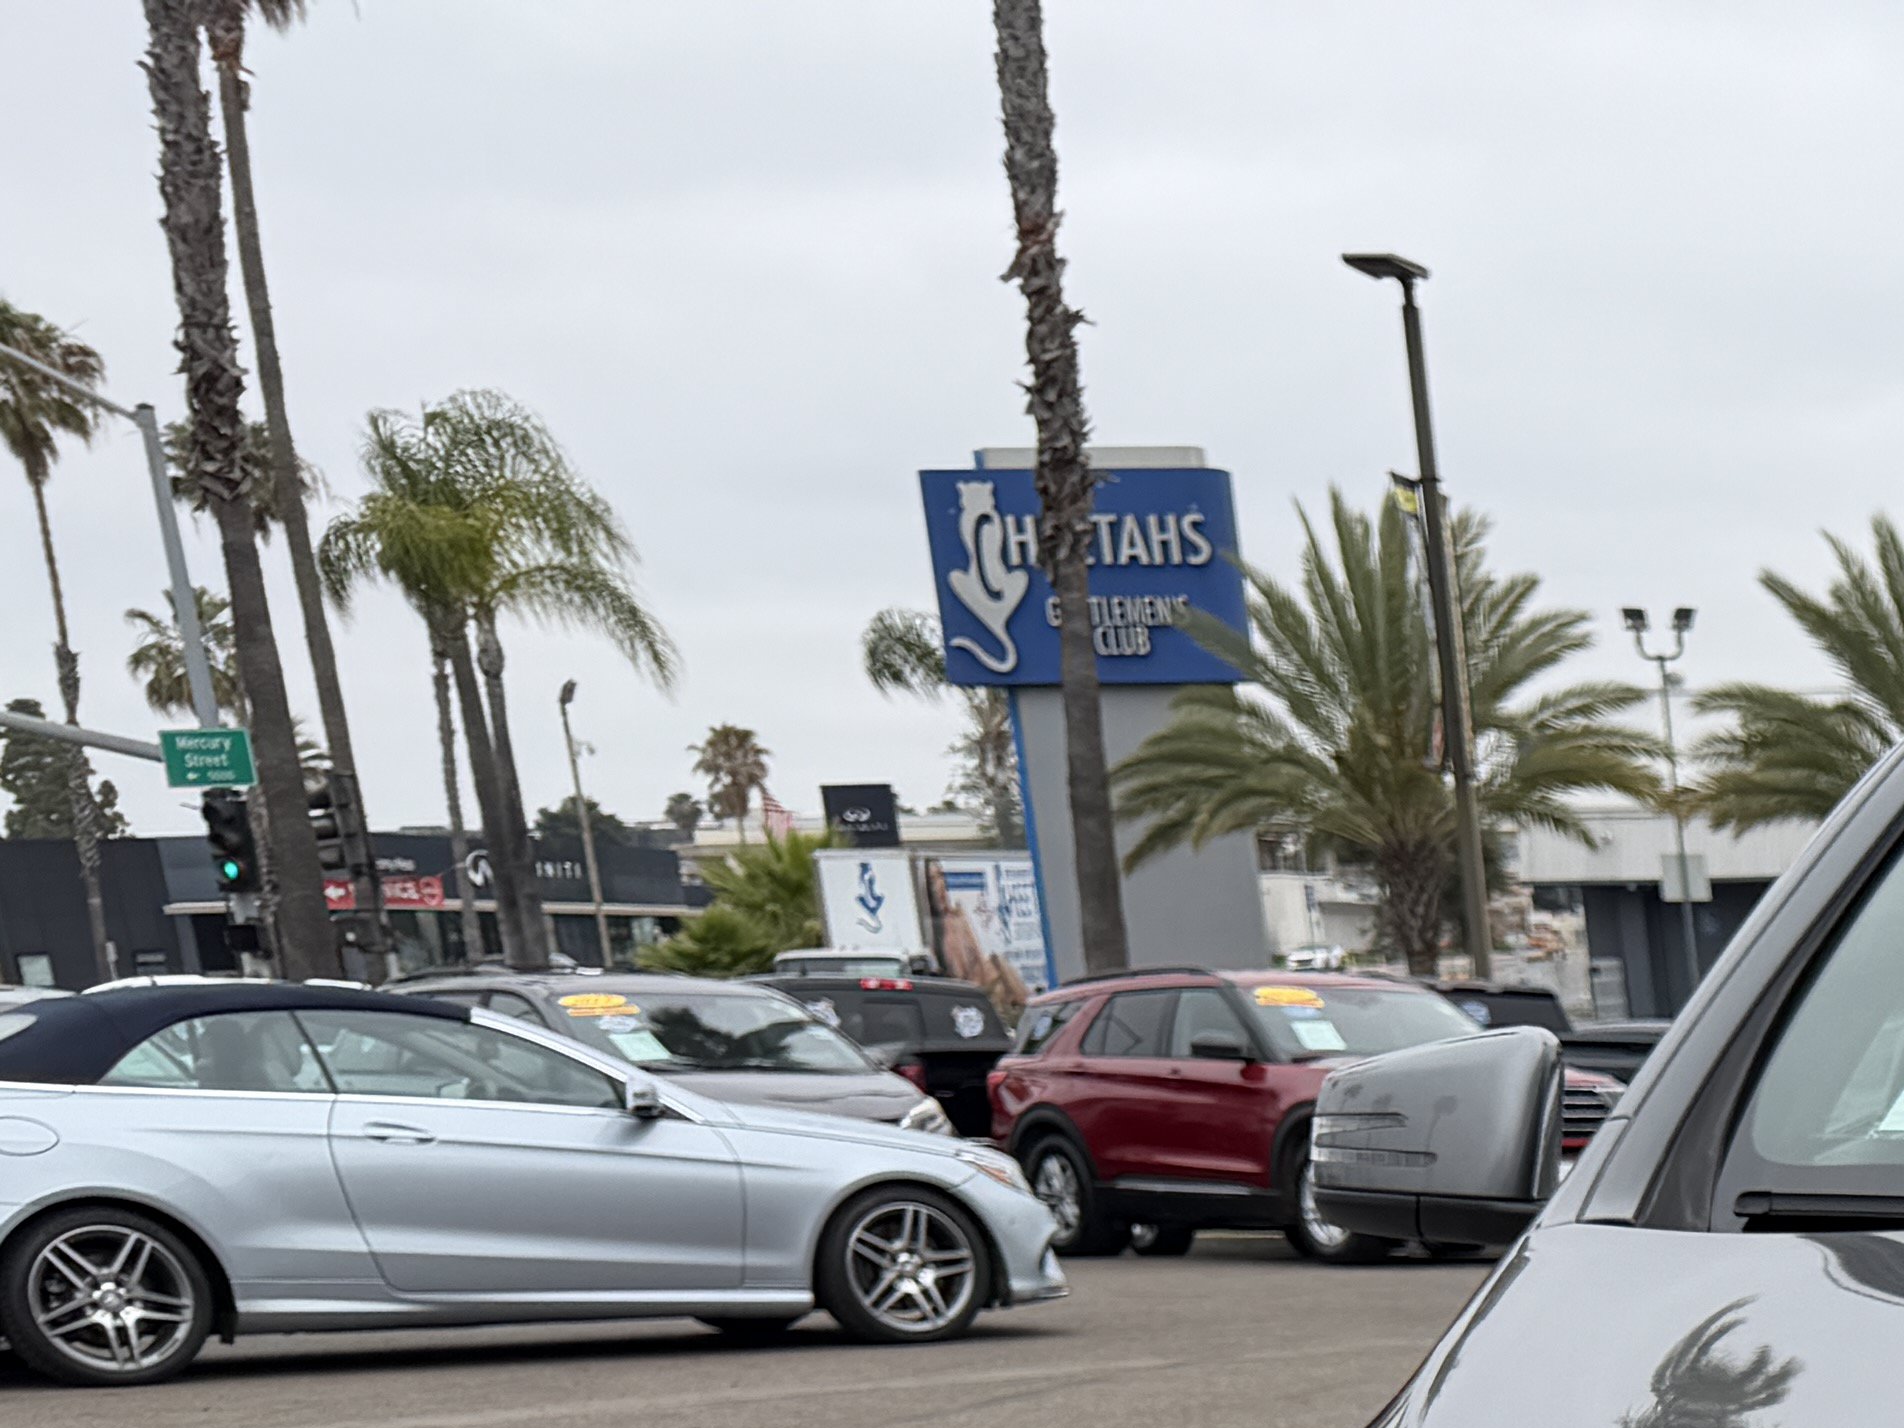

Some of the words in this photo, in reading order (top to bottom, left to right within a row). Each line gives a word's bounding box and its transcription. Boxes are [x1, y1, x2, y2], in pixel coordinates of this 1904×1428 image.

[1094, 626, 1151, 656] CLUB
[175, 736, 232, 752] Mercury
[184, 752, 229, 768] Street
